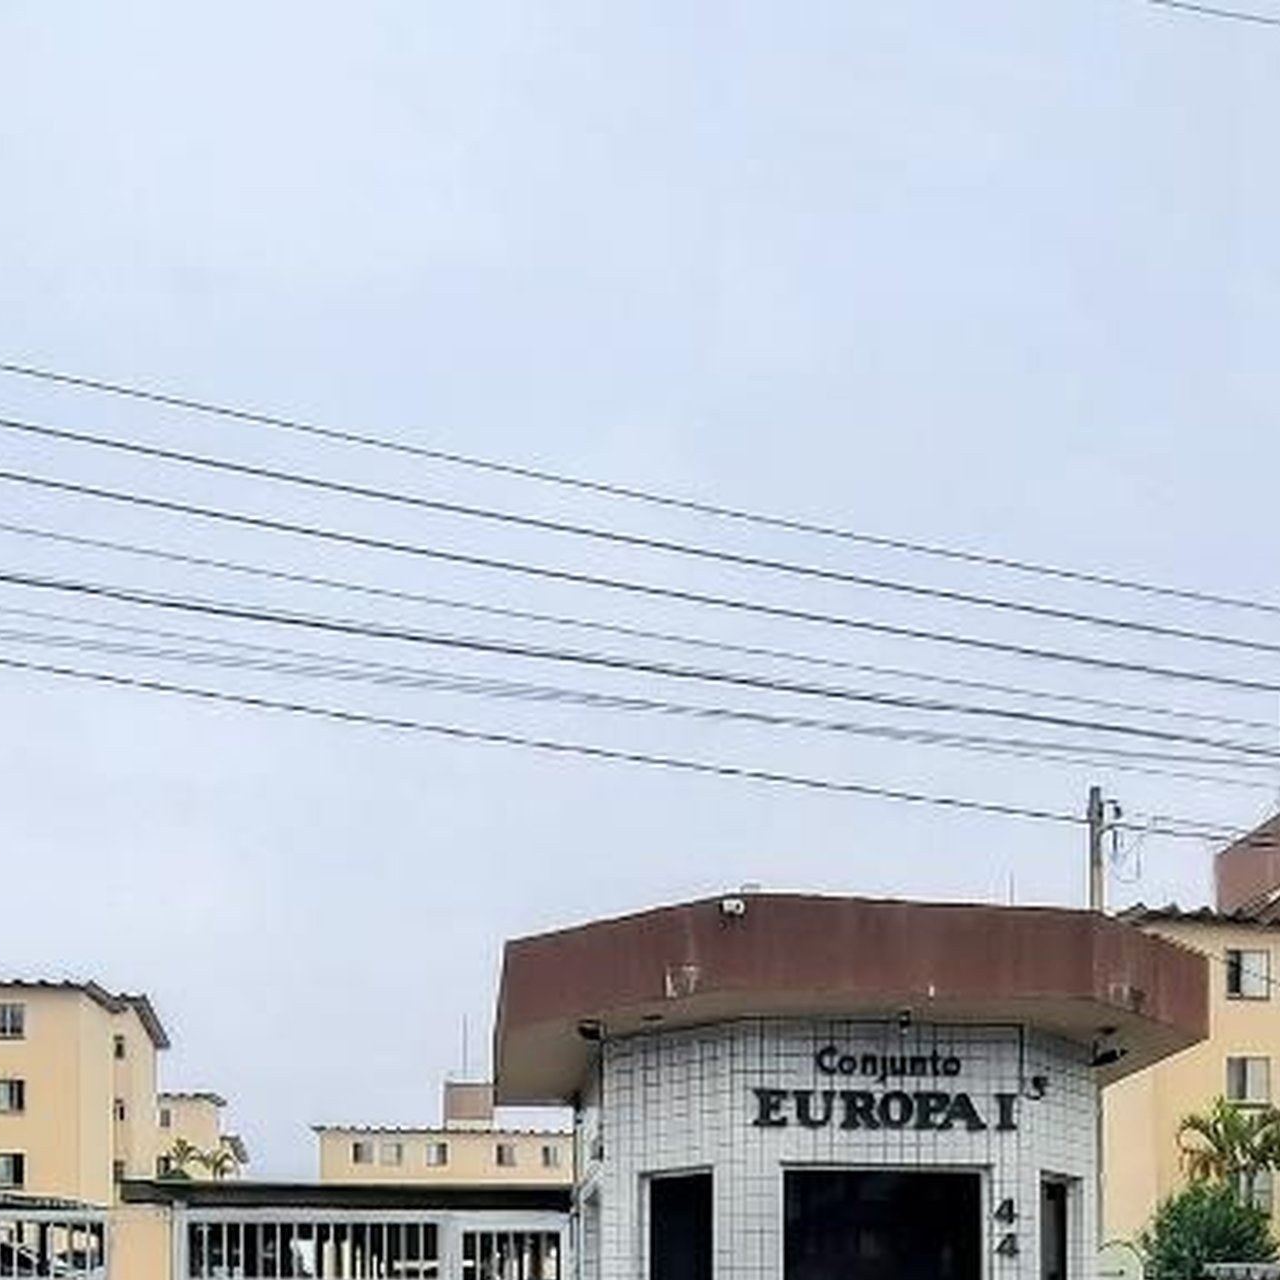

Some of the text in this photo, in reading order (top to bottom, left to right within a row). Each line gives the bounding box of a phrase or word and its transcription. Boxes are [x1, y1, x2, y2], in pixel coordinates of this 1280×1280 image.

[817, 1047, 961, 1081] Conjunto
[753, 1088, 1018, 1131] EUROPA I
